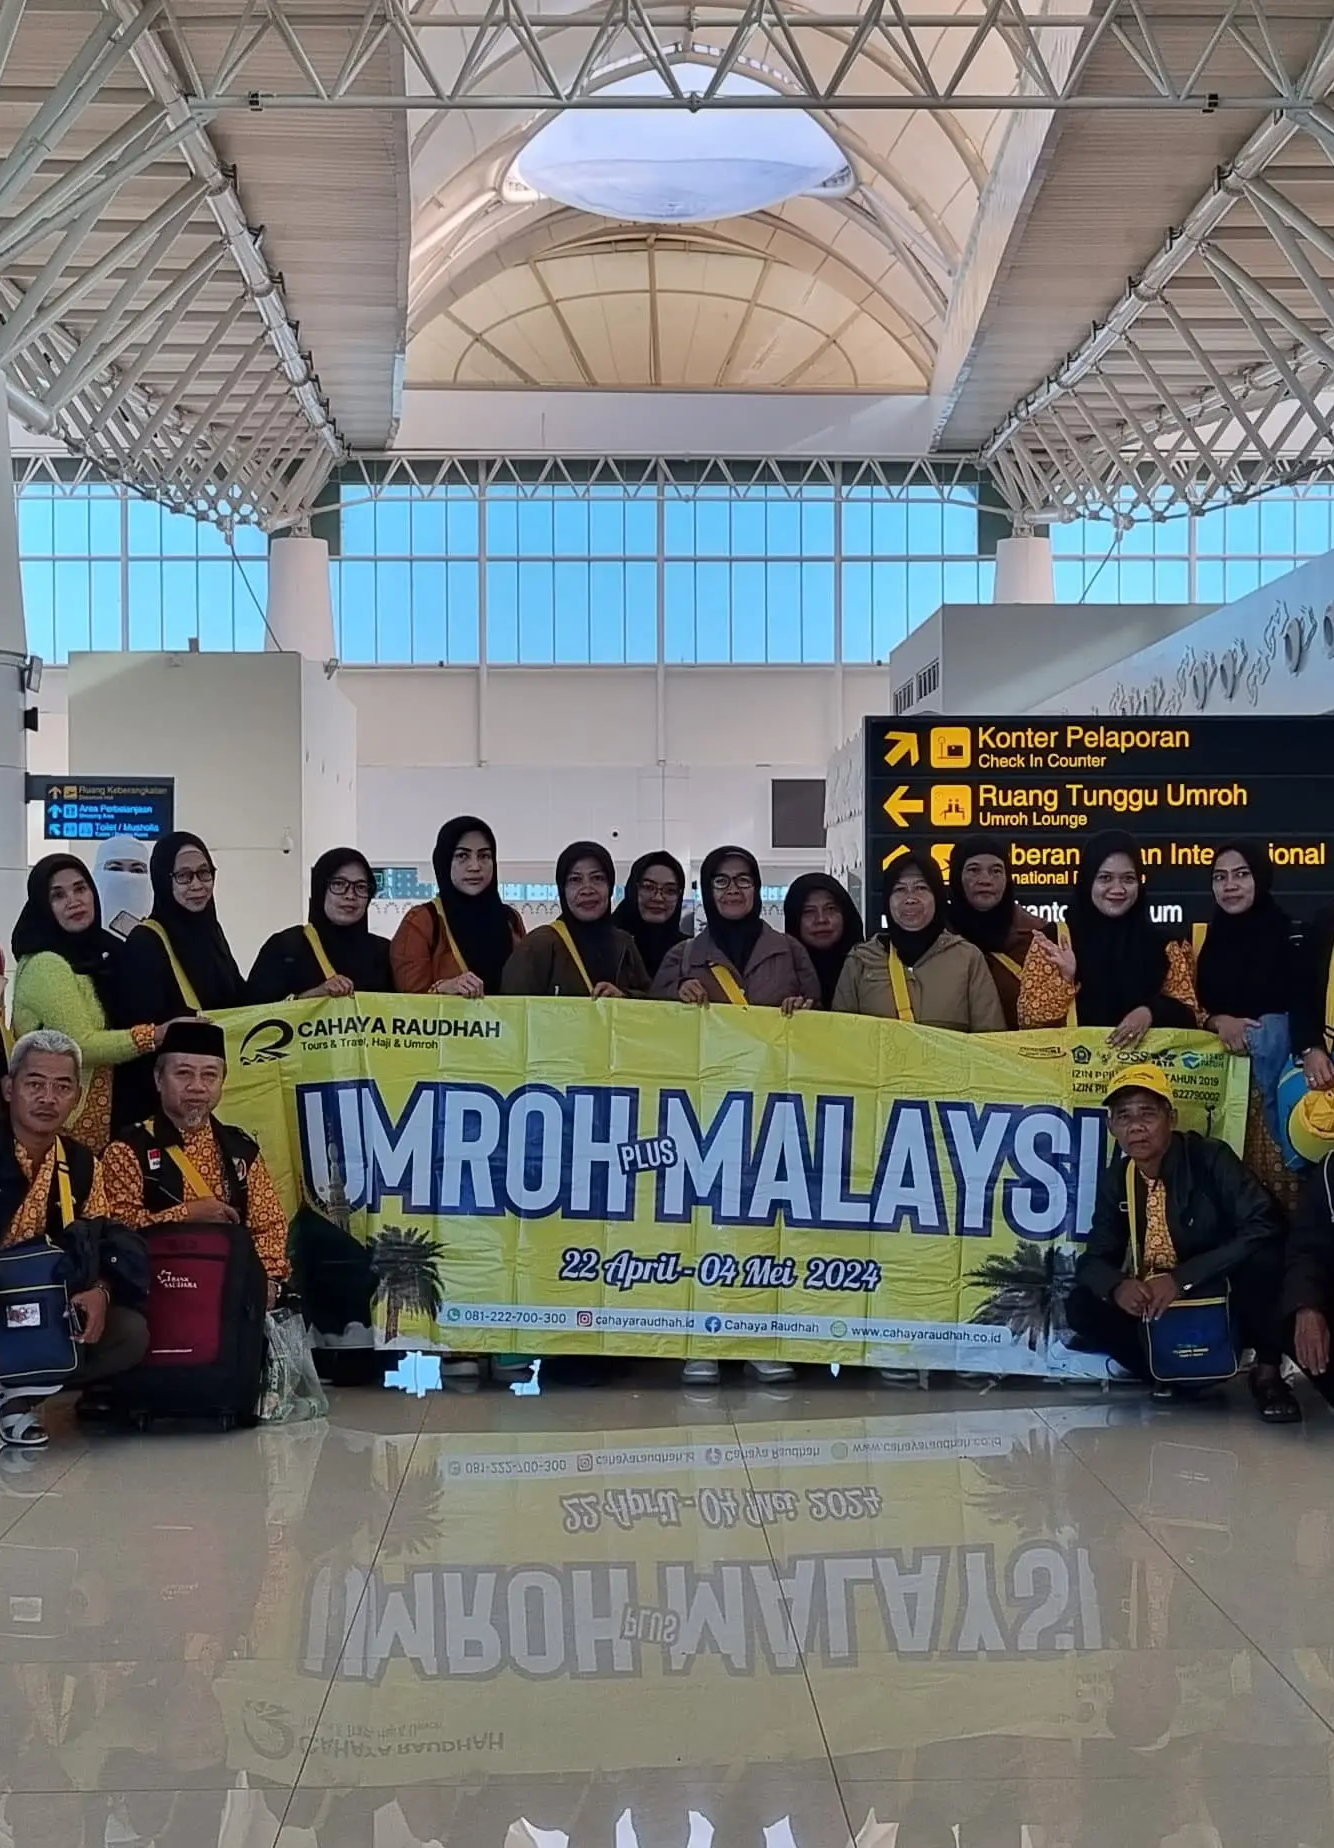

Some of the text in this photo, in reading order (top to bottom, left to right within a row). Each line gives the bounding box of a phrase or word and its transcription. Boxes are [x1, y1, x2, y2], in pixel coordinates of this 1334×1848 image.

[978, 726, 1190, 754] Konter Pelaporan
[978, 753, 1107, 768] Check In Counter
[978, 783, 1248, 812] Ruang Tunggu Umroh
[978, 812, 1088, 829] Umroh Lounge
[297, 1016, 501, 1038] CAHAYA RAUDHAH
[301, 1041, 328, 1051] Tours
[330, 1040, 337, 1049] &
[371, 1038, 392, 1050] Haji
[394, 1039, 401, 1048] &
[404, 1040, 438, 1050] Umroh
[1072, 1069, 1093, 1079] IZIN
[1165, 1073, 1197, 1085] TAHUN
[1198, 1075, 1219, 1086] 2019
[1072, 1082, 1093, 1093] IZIN
[301, 1086, 1107, 1239] UMROH MALAYSI
[620, 1138, 677, 1175] PLUS
[561, 1248, 600, 1281] 22
[604, 1250, 680, 1290] April
[699, 1254, 738, 1286] 04
[743, 1256, 796, 1288] Mei
[806, 1257, 882, 1291] 2024
[464, 1310, 567, 1325] 081-222-700-300
[595, 1313, 695, 1330] cahayaraudhah.id
[724, 1318, 820, 1333] Cahaya Raudhah
[850, 1326, 1003, 1345] www.cahayaraudhah.co.id
